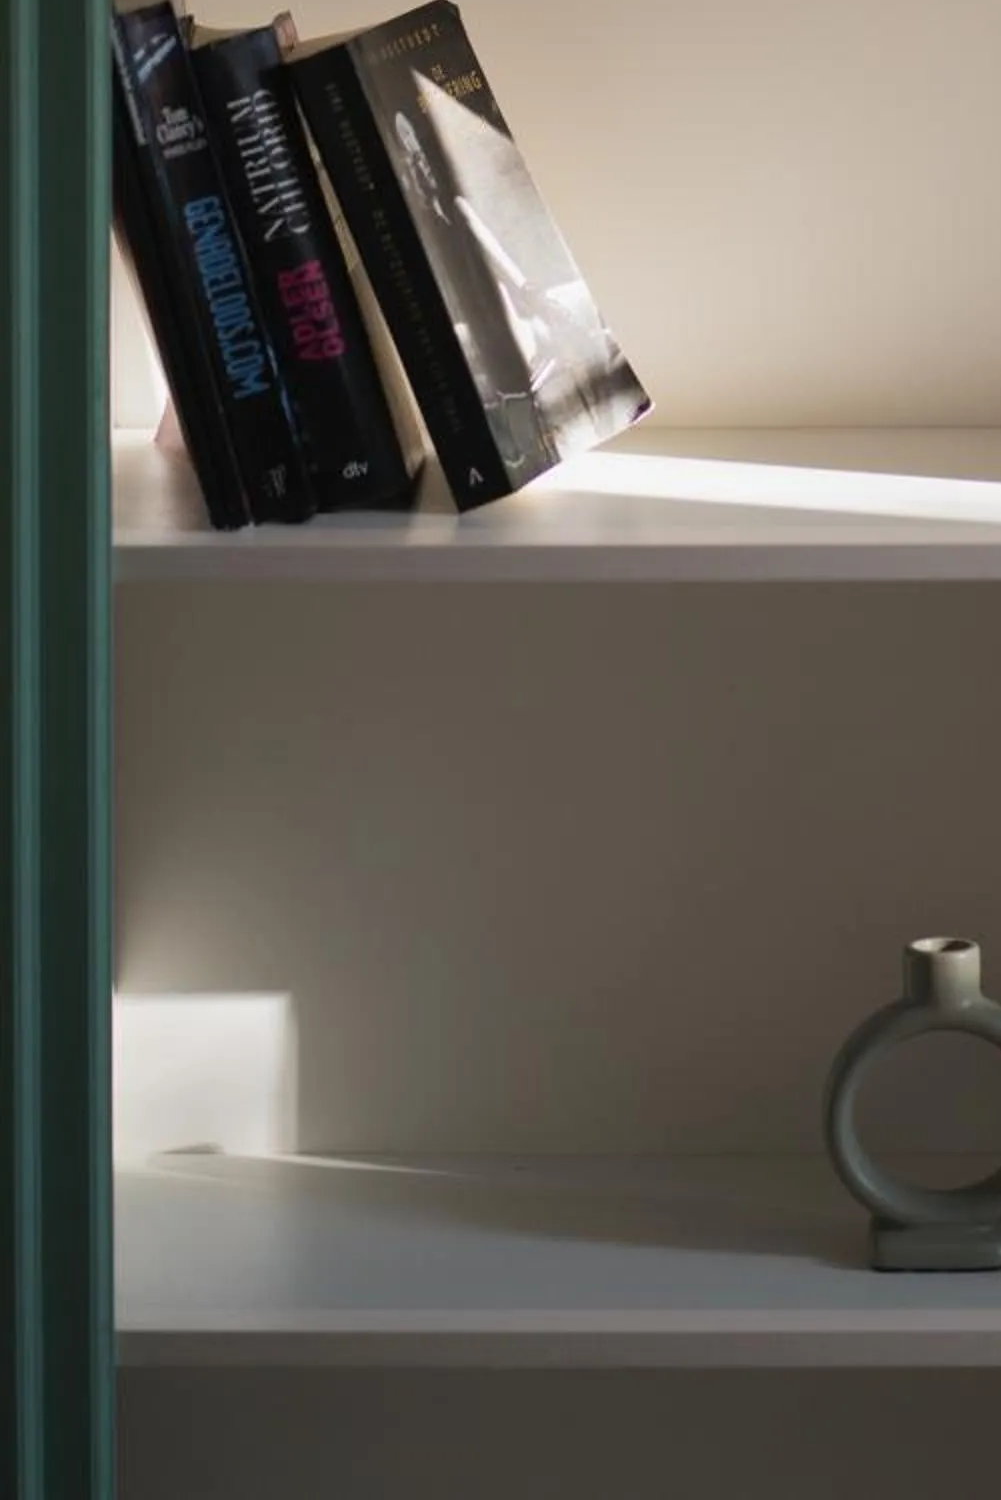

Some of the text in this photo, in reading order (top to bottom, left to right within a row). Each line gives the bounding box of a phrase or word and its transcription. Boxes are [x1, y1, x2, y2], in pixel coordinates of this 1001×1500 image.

[226, 96, 287, 242] NATRIUM
[252, 89, 311, 235] CHLORID
[277, 268, 318, 361] ADLER
[301, 258, 346, 359] OLSEN
